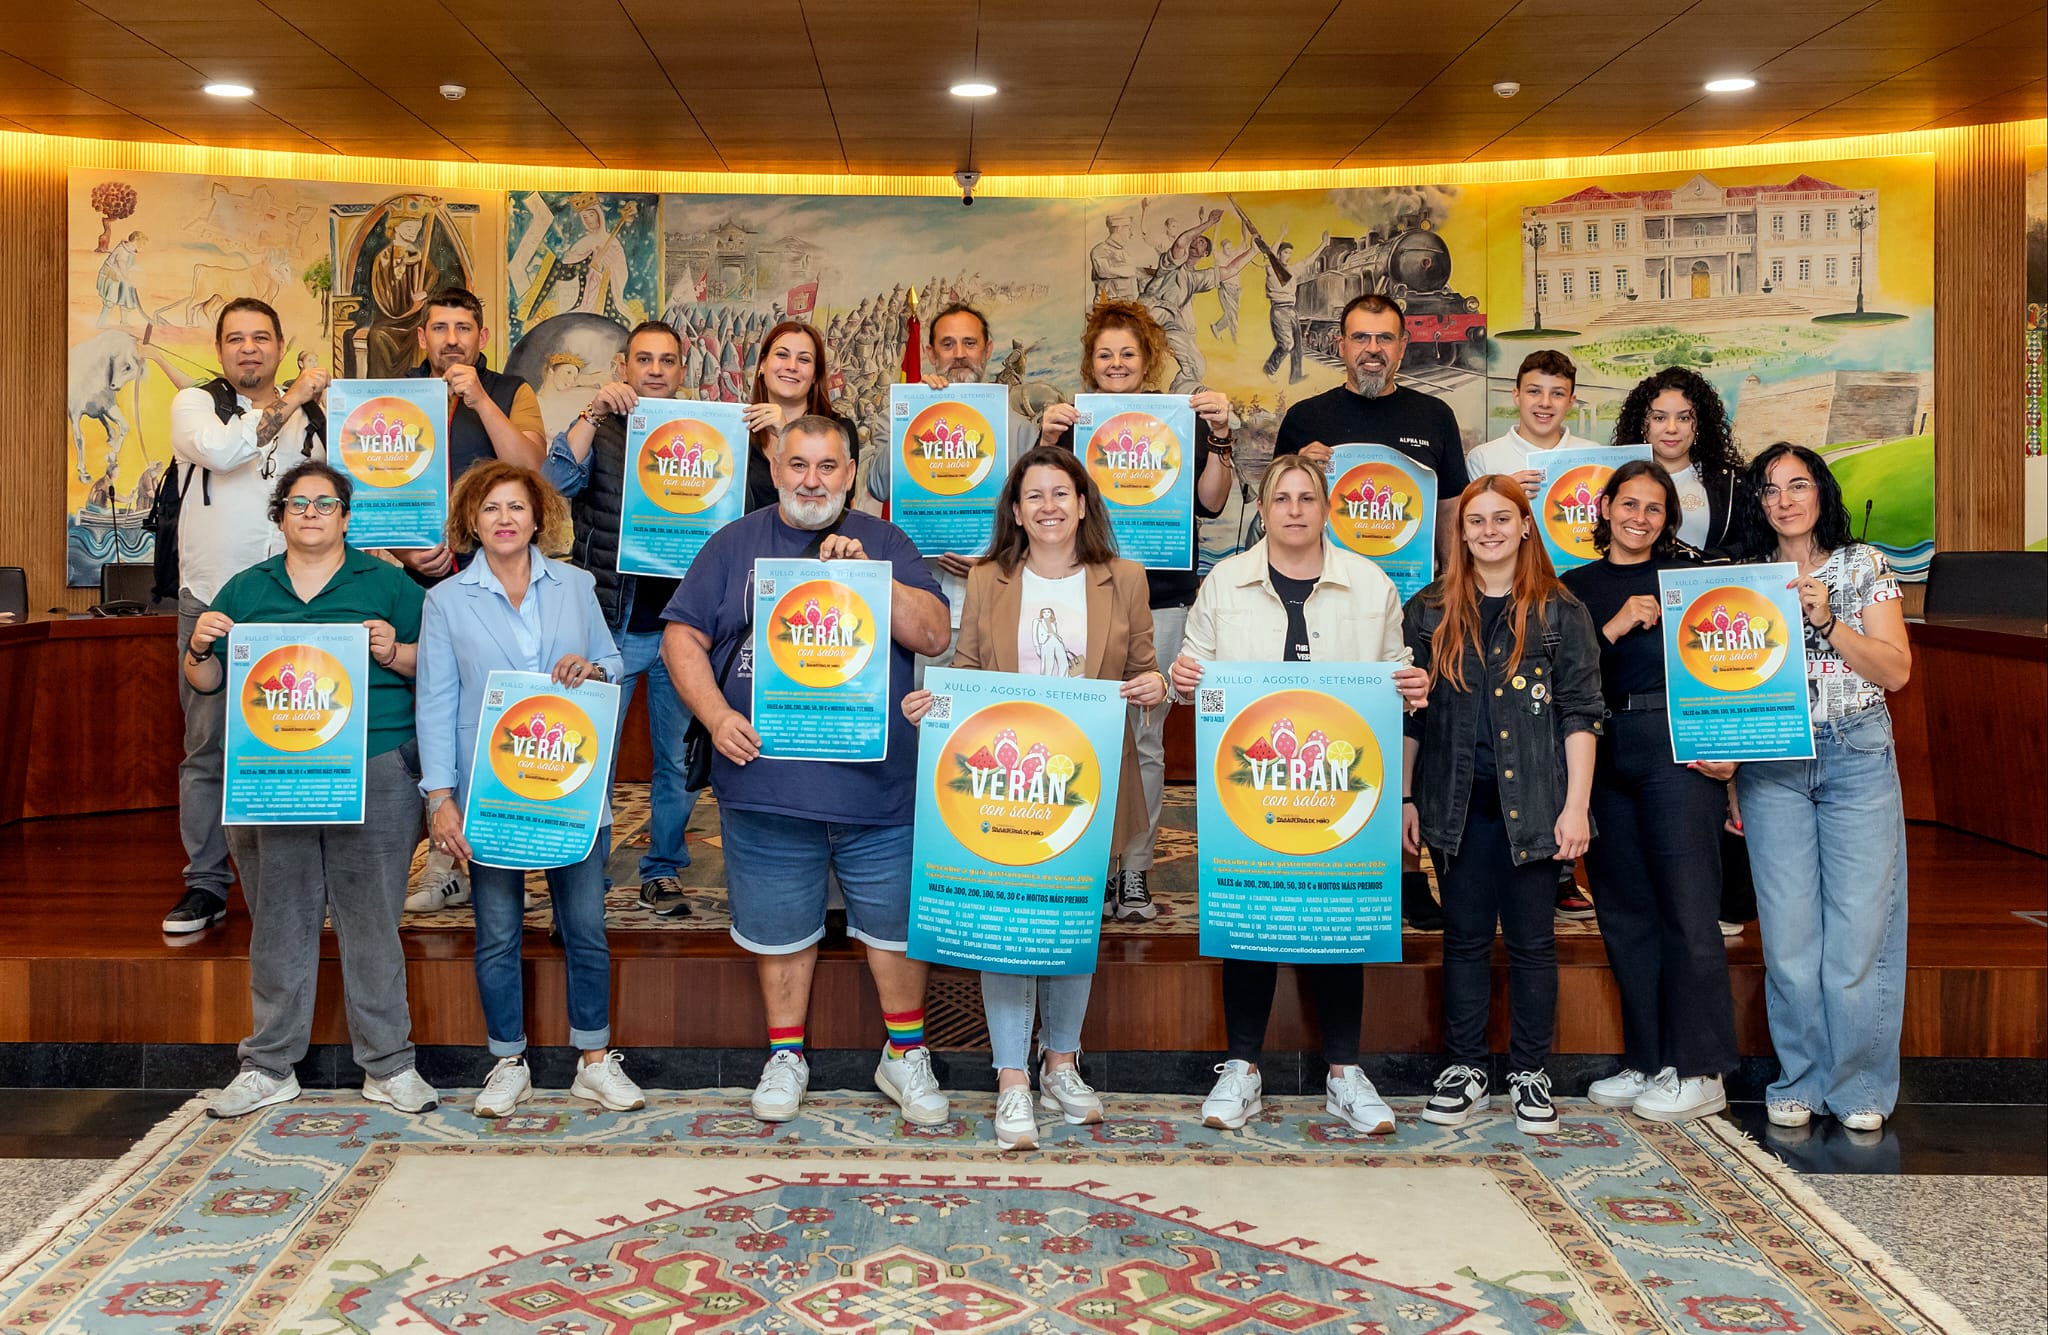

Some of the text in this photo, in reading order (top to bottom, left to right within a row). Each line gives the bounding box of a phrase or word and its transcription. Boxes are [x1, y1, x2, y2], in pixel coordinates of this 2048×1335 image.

[922, 436, 977, 459] VERÁN
[657, 456, 715, 479] VERÁN
[1106, 447, 1163, 470] VERÁN
[1348, 497, 1404, 521] VERÁN
[1564, 504, 1598, 525] VER
[790, 621, 854, 647] VERÁN
[1700, 625, 1767, 653] VERÁN
[797, 646, 847, 657] con sabor
[1709, 650, 1758, 663] con sabor
[1216, 676, 1382, 685] XULLO AGOSTO SETEMBRO
[264, 686, 331, 711] VERÁN
[944, 682, 1107, 703] XULLO AGOSTO SETEMBRO
[272, 709, 321, 721] con sabor
[512, 735, 578, 764] VERÁN
[517, 759, 565, 772] con sabor
[1250, 753, 1348, 791] VERÁN
[971, 766, 1068, 806] VERÁN
[1262, 790, 1336, 807] con sabor
[979, 801, 1052, 820] con sabor
[929, 883, 945, 892] VALES
[946, 886, 953, 894] de
[954, 886, 967, 896] 300,
[968, 888, 982, 897] 200,
[983, 890, 995, 899] 100,
[996, 891, 1006, 900] 50,
[1007, 892, 1014, 900] 30
[1026, 893, 1048, 903] MOITOS
[1049, 893, 1063, 903] MÁIS
[1064, 896, 1088, 904] PREMIOS
[1217, 878, 1234, 887] VALES
[1235, 879, 1242, 887] de
[1258, 881, 1272, 890] 200,
[1273, 881, 1286, 890] 100,
[1287, 882, 1297, 890] 50,
[1318, 882, 1340, 890] MOITOS
[1342, 880, 1356, 890] MÁIS
[1358, 882, 1383, 890] PREMIOS
[936, 948, 1066, 966] veranconsabor.concellodesalvaterra.com
[1230, 944, 1365, 954] veranconsabor.concellodesalvaterra.com
